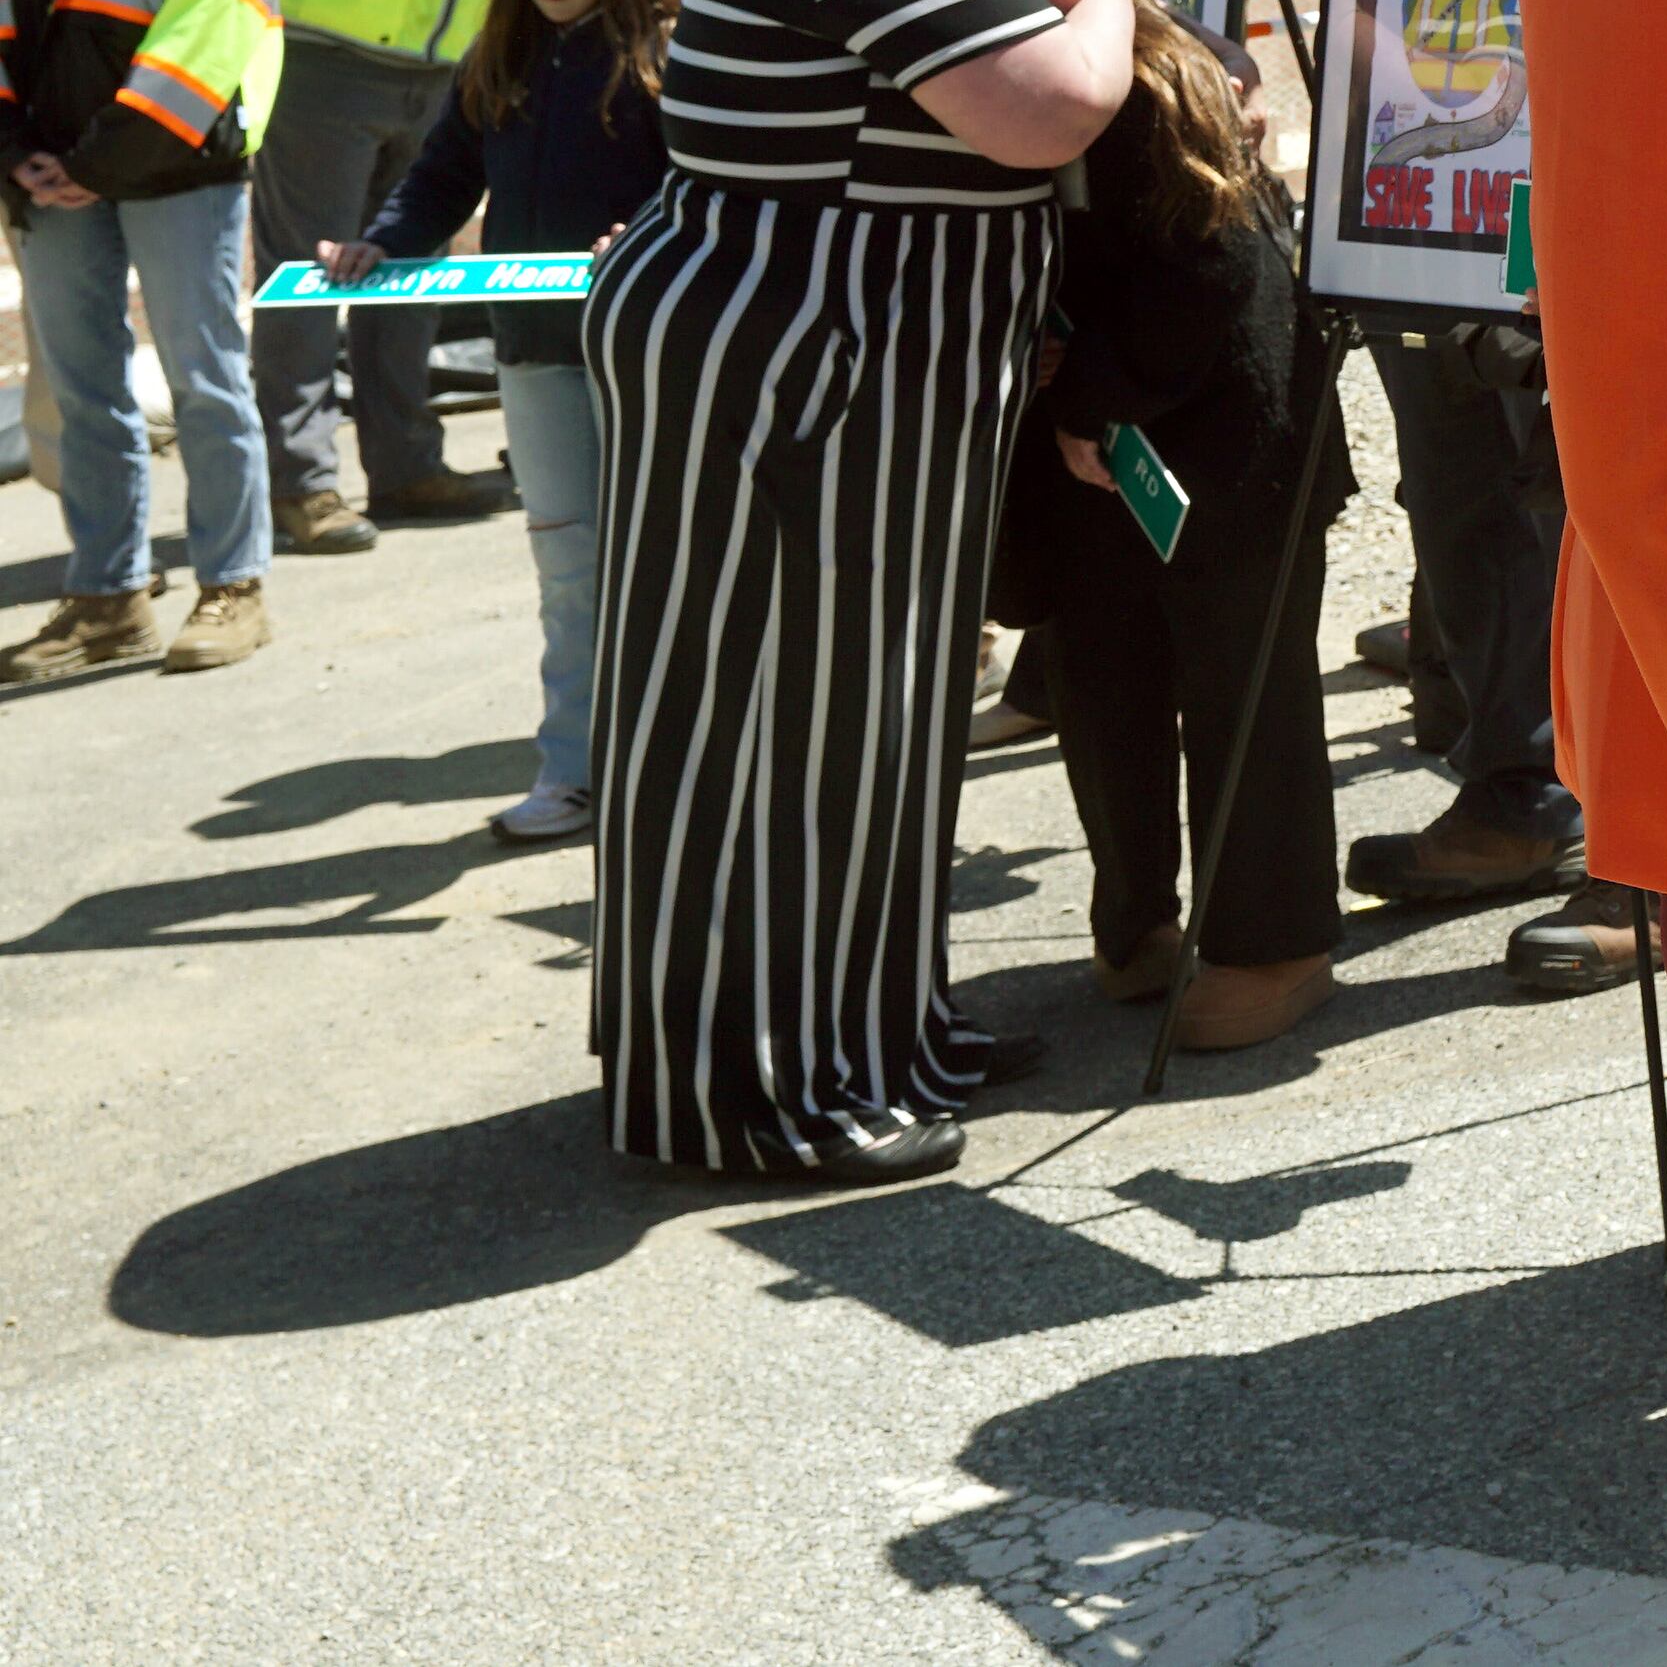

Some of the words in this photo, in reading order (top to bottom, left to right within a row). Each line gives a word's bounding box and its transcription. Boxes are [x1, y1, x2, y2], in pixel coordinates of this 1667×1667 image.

[1366, 165, 1435, 229] SAVE
[1452, 168, 1528, 234] LIVE
[1134, 457, 1160, 499] RD
